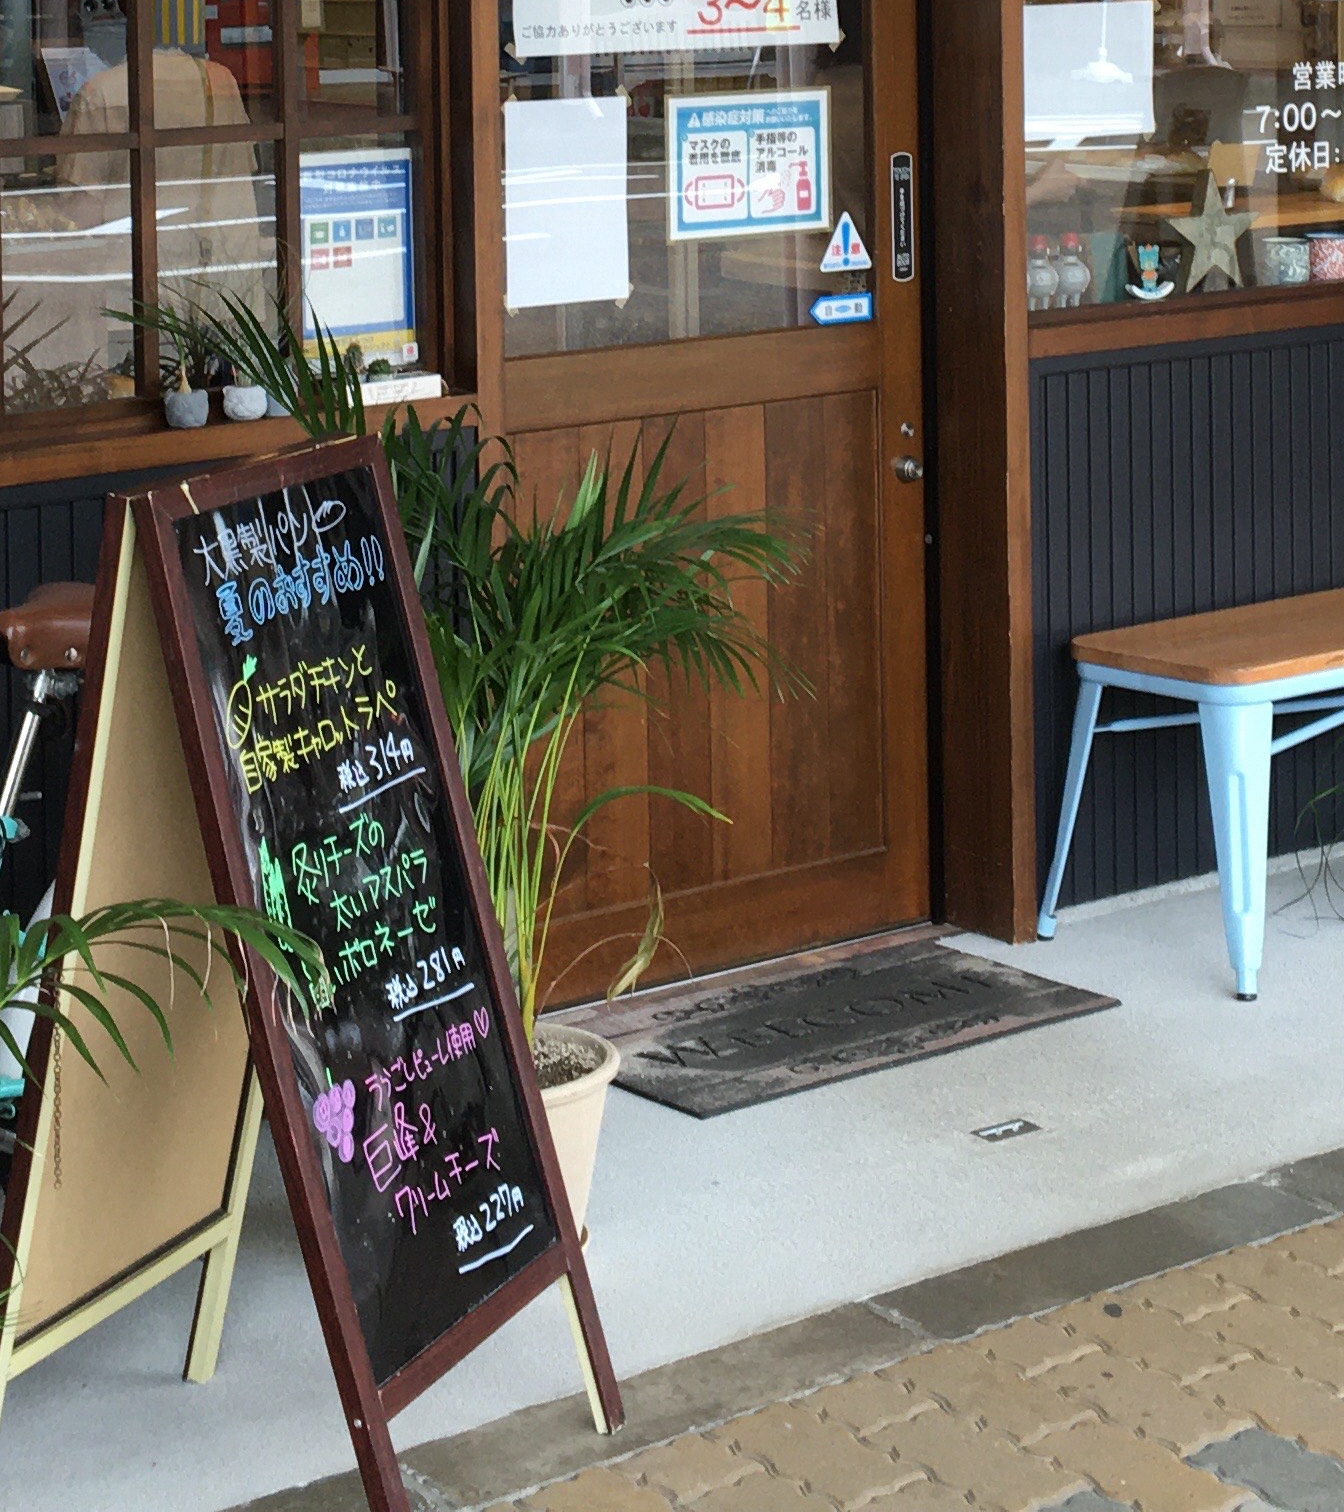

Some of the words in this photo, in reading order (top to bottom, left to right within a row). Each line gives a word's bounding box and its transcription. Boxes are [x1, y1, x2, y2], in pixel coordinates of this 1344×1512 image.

[520, 20, 678, 39] ご協力ありがとうございます
[688, 138, 731, 151] マスクの
[756, 144, 809, 159] アルコール
[193, 510, 308, 586] 大黒製パン
[256, 644, 373, 725] サラダチキンと
[239, 679, 398, 794] 自家製キャロットラペ
[329, 848, 428, 932] 太いアスパラ
[394, 1127, 501, 1236] クリームチーズ
